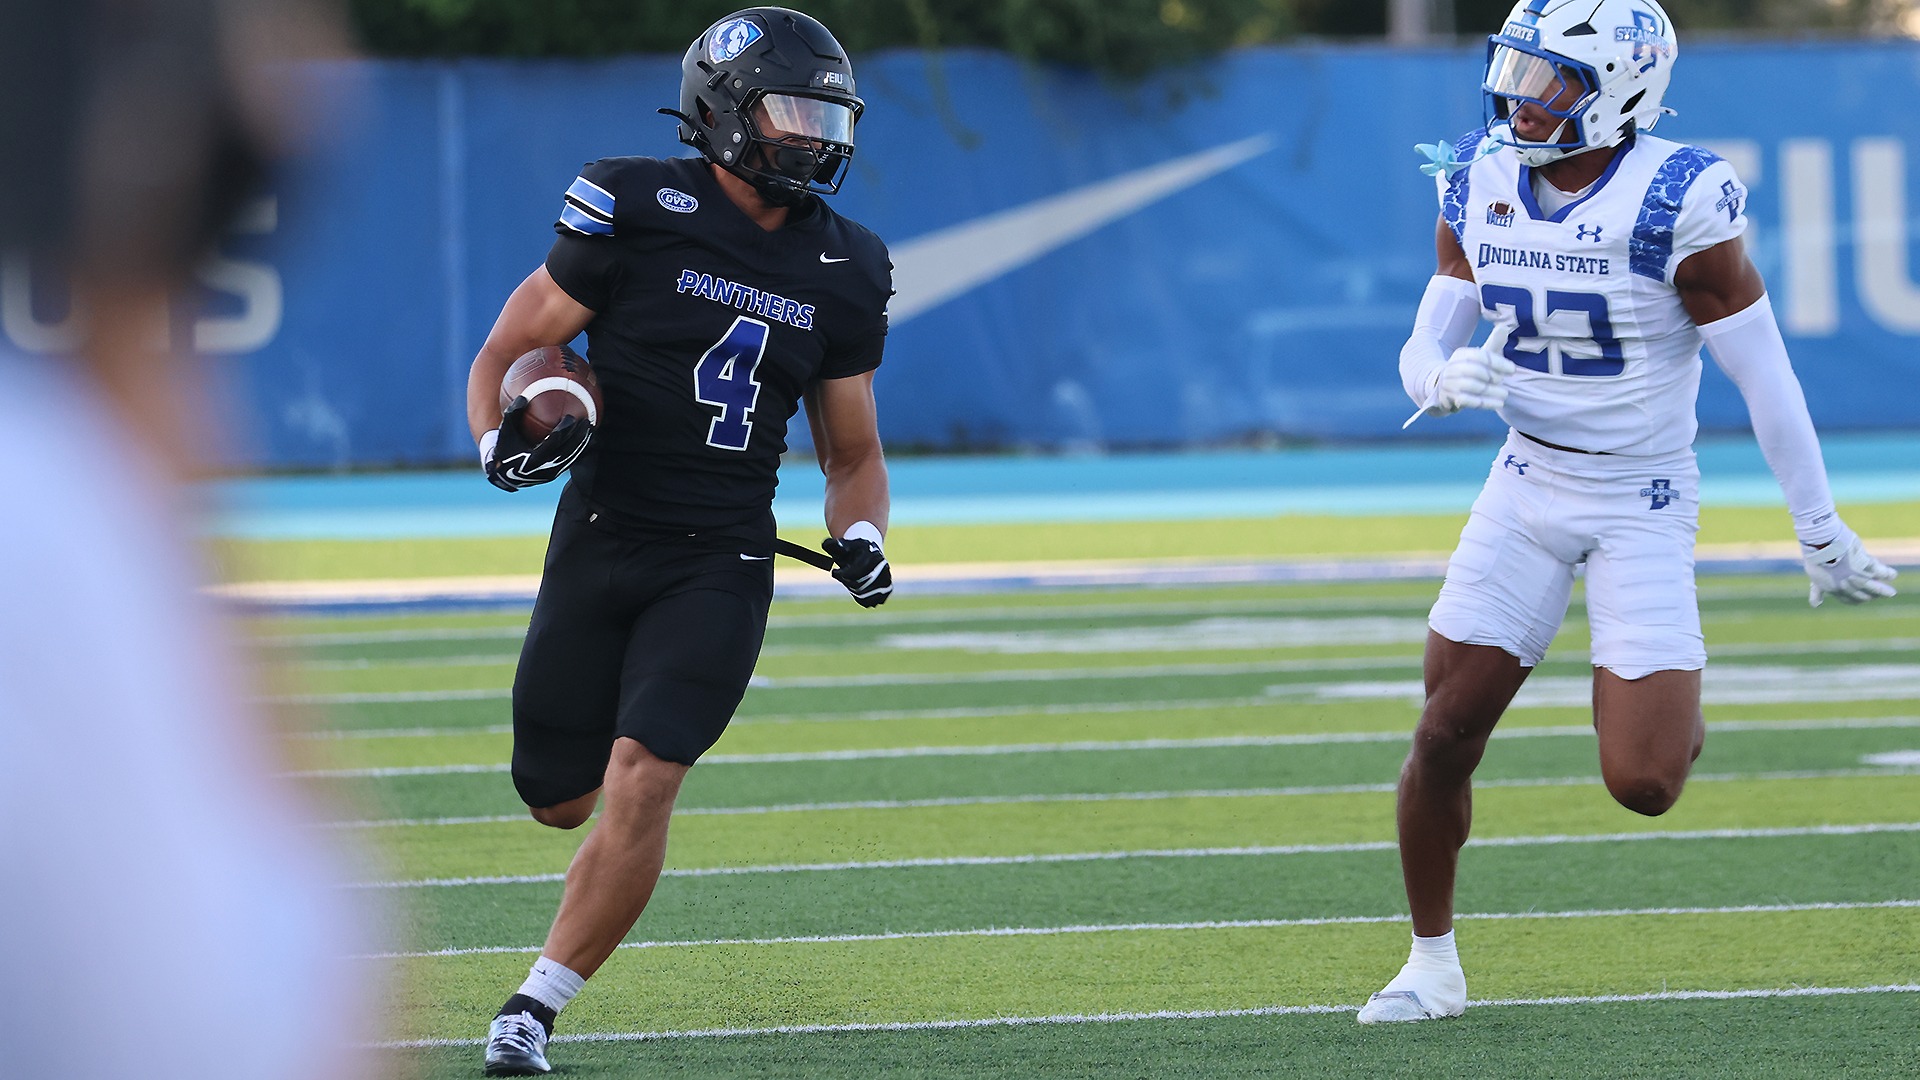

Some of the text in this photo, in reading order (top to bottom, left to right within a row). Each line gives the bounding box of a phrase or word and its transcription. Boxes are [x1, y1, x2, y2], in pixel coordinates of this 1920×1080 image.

[1504, 23, 1536, 42] STATE
[829, 72, 843, 84] EIU
[665, 194, 688, 207] OVC
[1486, 207, 1515, 228] VALLEY
[1478, 243, 1609, 275] INDIANA STATE
[677, 269, 815, 330] PANTHERS
[1481, 283, 1626, 377] 23
[694, 316, 769, 451] 4
